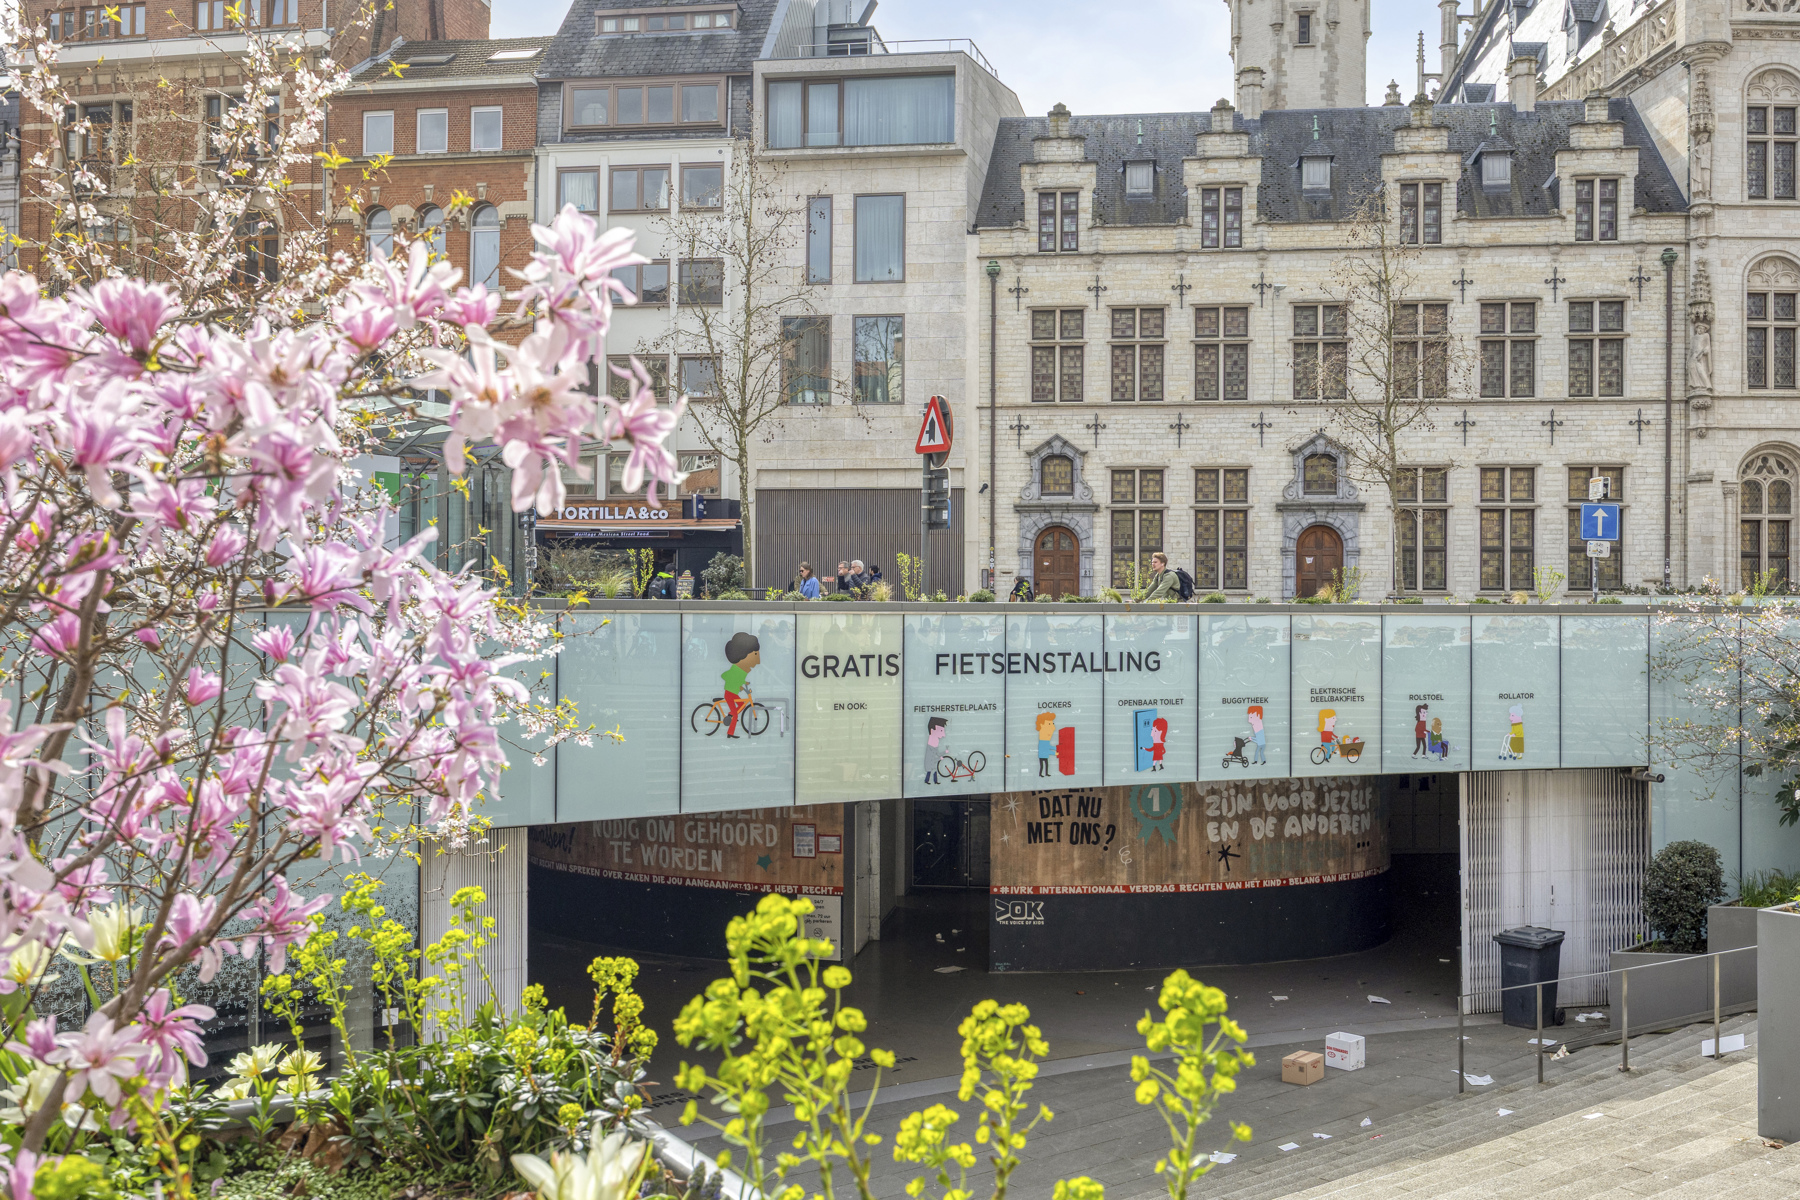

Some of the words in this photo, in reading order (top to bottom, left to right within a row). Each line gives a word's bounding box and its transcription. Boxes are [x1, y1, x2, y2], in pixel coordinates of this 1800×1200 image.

[936, 651, 1161, 675] FIETSENSTALLING
[1310, 687, 1356, 695] ELEKTRISCHE
[1310, 695, 1365, 703] DEEL(BAK)FIETS
[1498, 692, 1535, 700] ROLLATOR
[913, 703, 997, 712] FIETSHERSTELPLAATS
[1037, 701, 1072, 709] LOCKERS
[1039, 794, 1073, 819] DAT
[1077, 795, 1102, 818] NU
[1147, 787, 1160, 812] 1
[646, 819, 675, 843] OM
[684, 821, 778, 847] GEHOORD
[1027, 821, 1063, 845] MET
[1069, 821, 1116, 852] ONS?
[1206, 821, 1239, 843] EN
[1250, 816, 1277, 840] DE
[1284, 811, 1371, 838] ANDEREN
[609, 841, 633, 864] TE
[641, 843, 723, 873] WORDEN
[555, 861, 568, 871] VAN
[568, 864, 600, 877] SPREKEN
[602, 869, 623, 880] OVER
[624, 872, 650, 882] ZAKEN
[652, 875, 665, 884] DIE
[667, 876, 683, 885] JOU
[685, 878, 728, 889] AANGAAN
[760, 884, 772, 893] JE
[775, 884, 799, 894] HEBT
[1000, 886, 1033, 895] #IVRK
[1039, 885, 1126, 894] INTERNATIONAAL
[1129, 884, 1176, 893] VERDRAG
[1179, 882, 1223, 892] RECHTEN
[1224, 881, 1242, 890] VAN
[1244, 880, 1261, 888] HET
[1262, 878, 1281, 887] KIND
[1288, 875, 1321, 885] BELANG
[1322, 874, 1337, 883] VAN
[1338, 872, 1350, 881] HET
